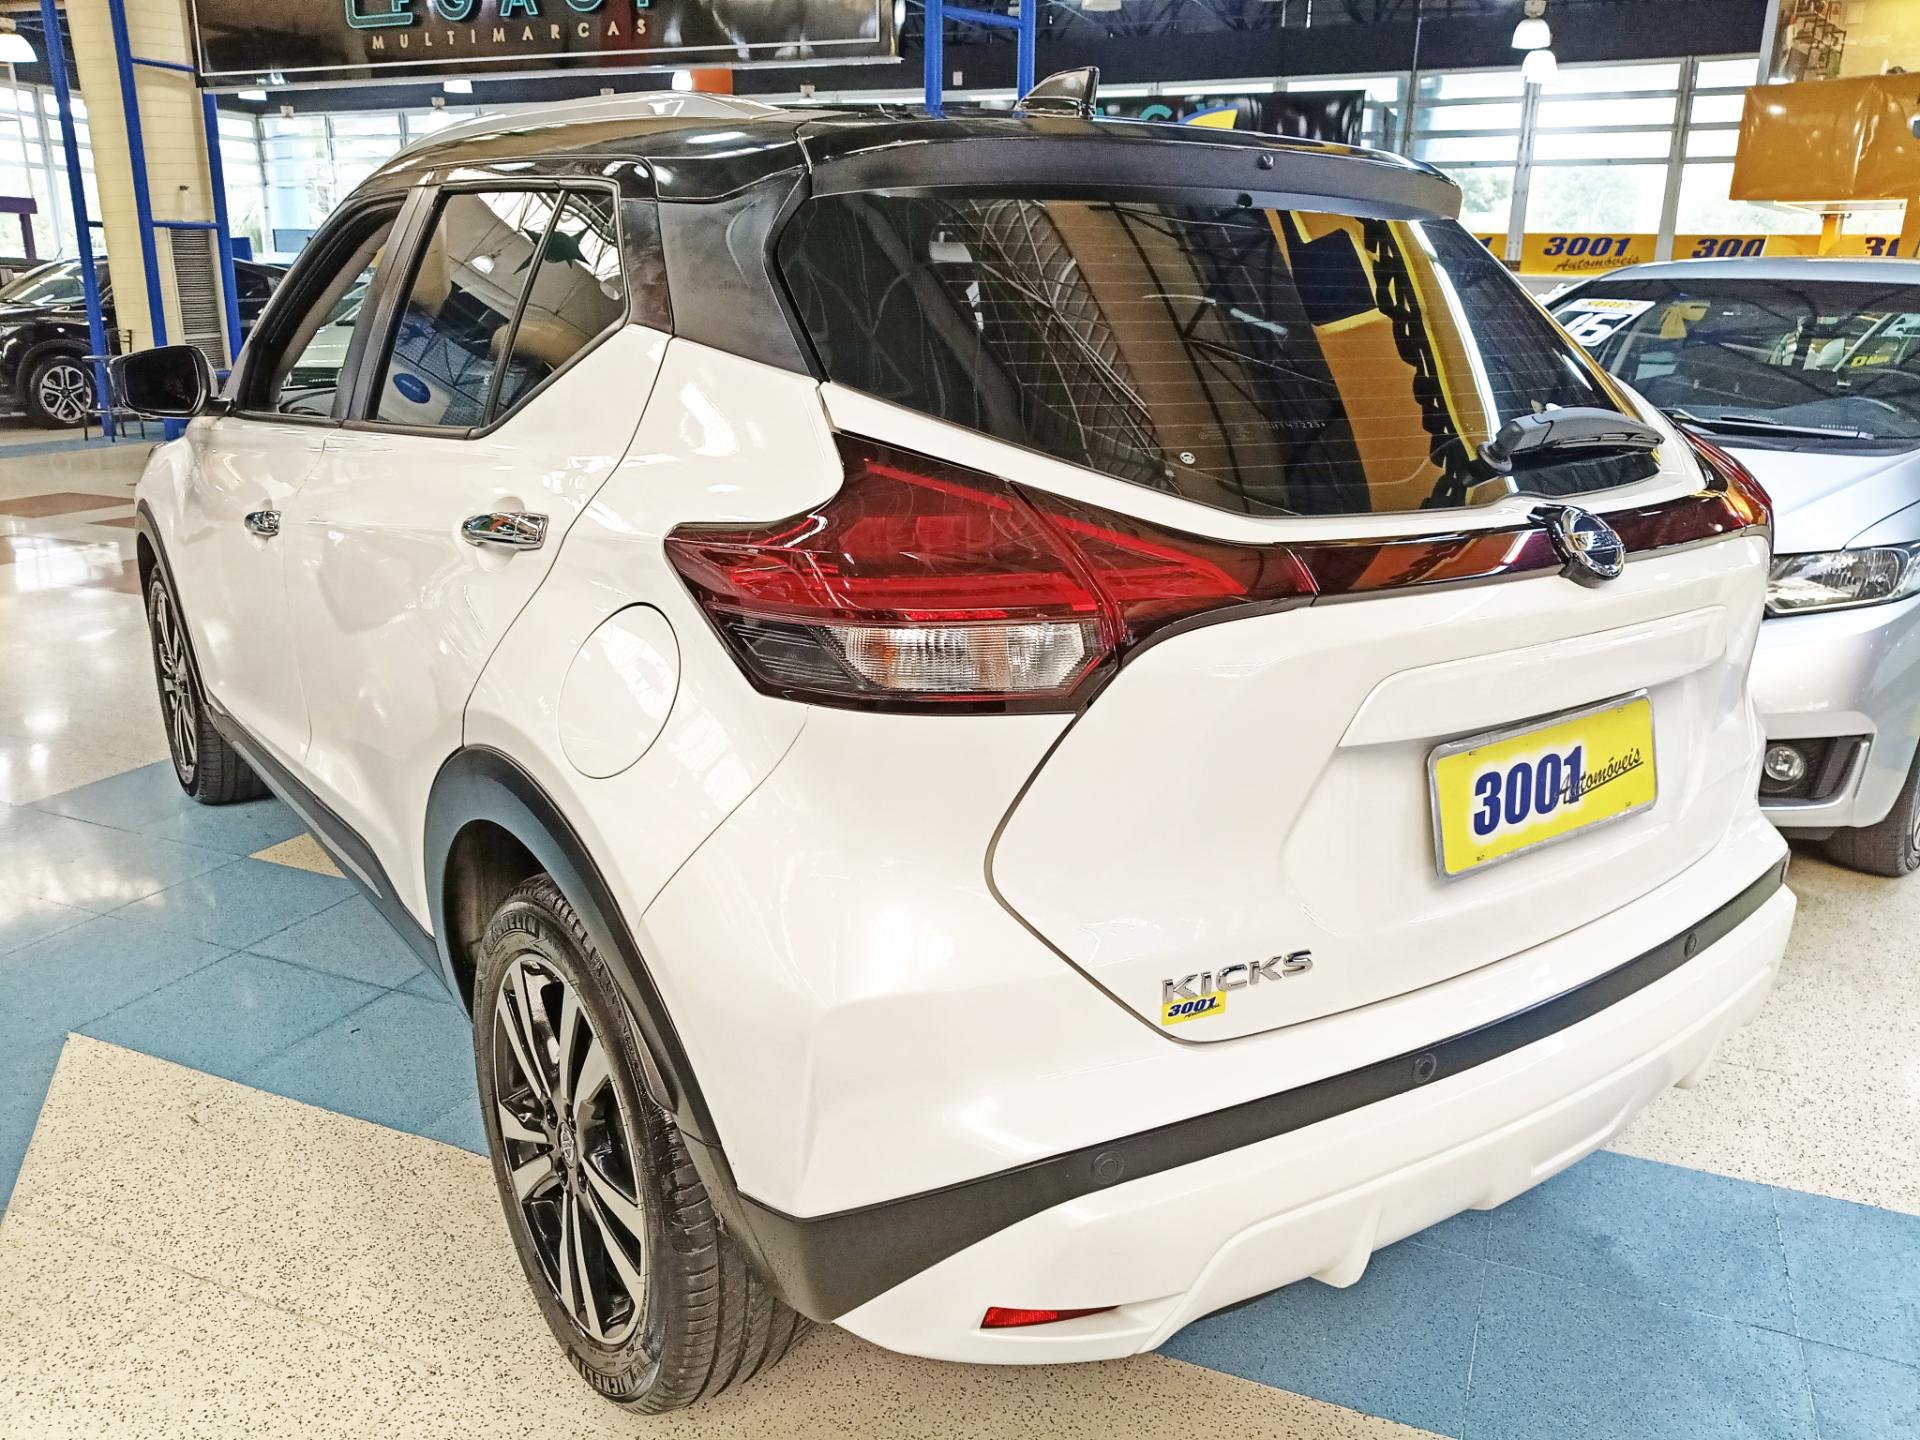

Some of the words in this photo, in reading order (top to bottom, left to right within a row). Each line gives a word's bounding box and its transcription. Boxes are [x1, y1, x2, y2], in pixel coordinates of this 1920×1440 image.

[371, 18, 647, 50] MULTIMARCAS
[1543, 236, 1631, 257] 3001
[1691, 238, 1766, 258] 300
[1474, 745, 1582, 836] 3001
[1162, 949, 1313, 1003] KICKS
[1167, 996, 1217, 1017] 3001
